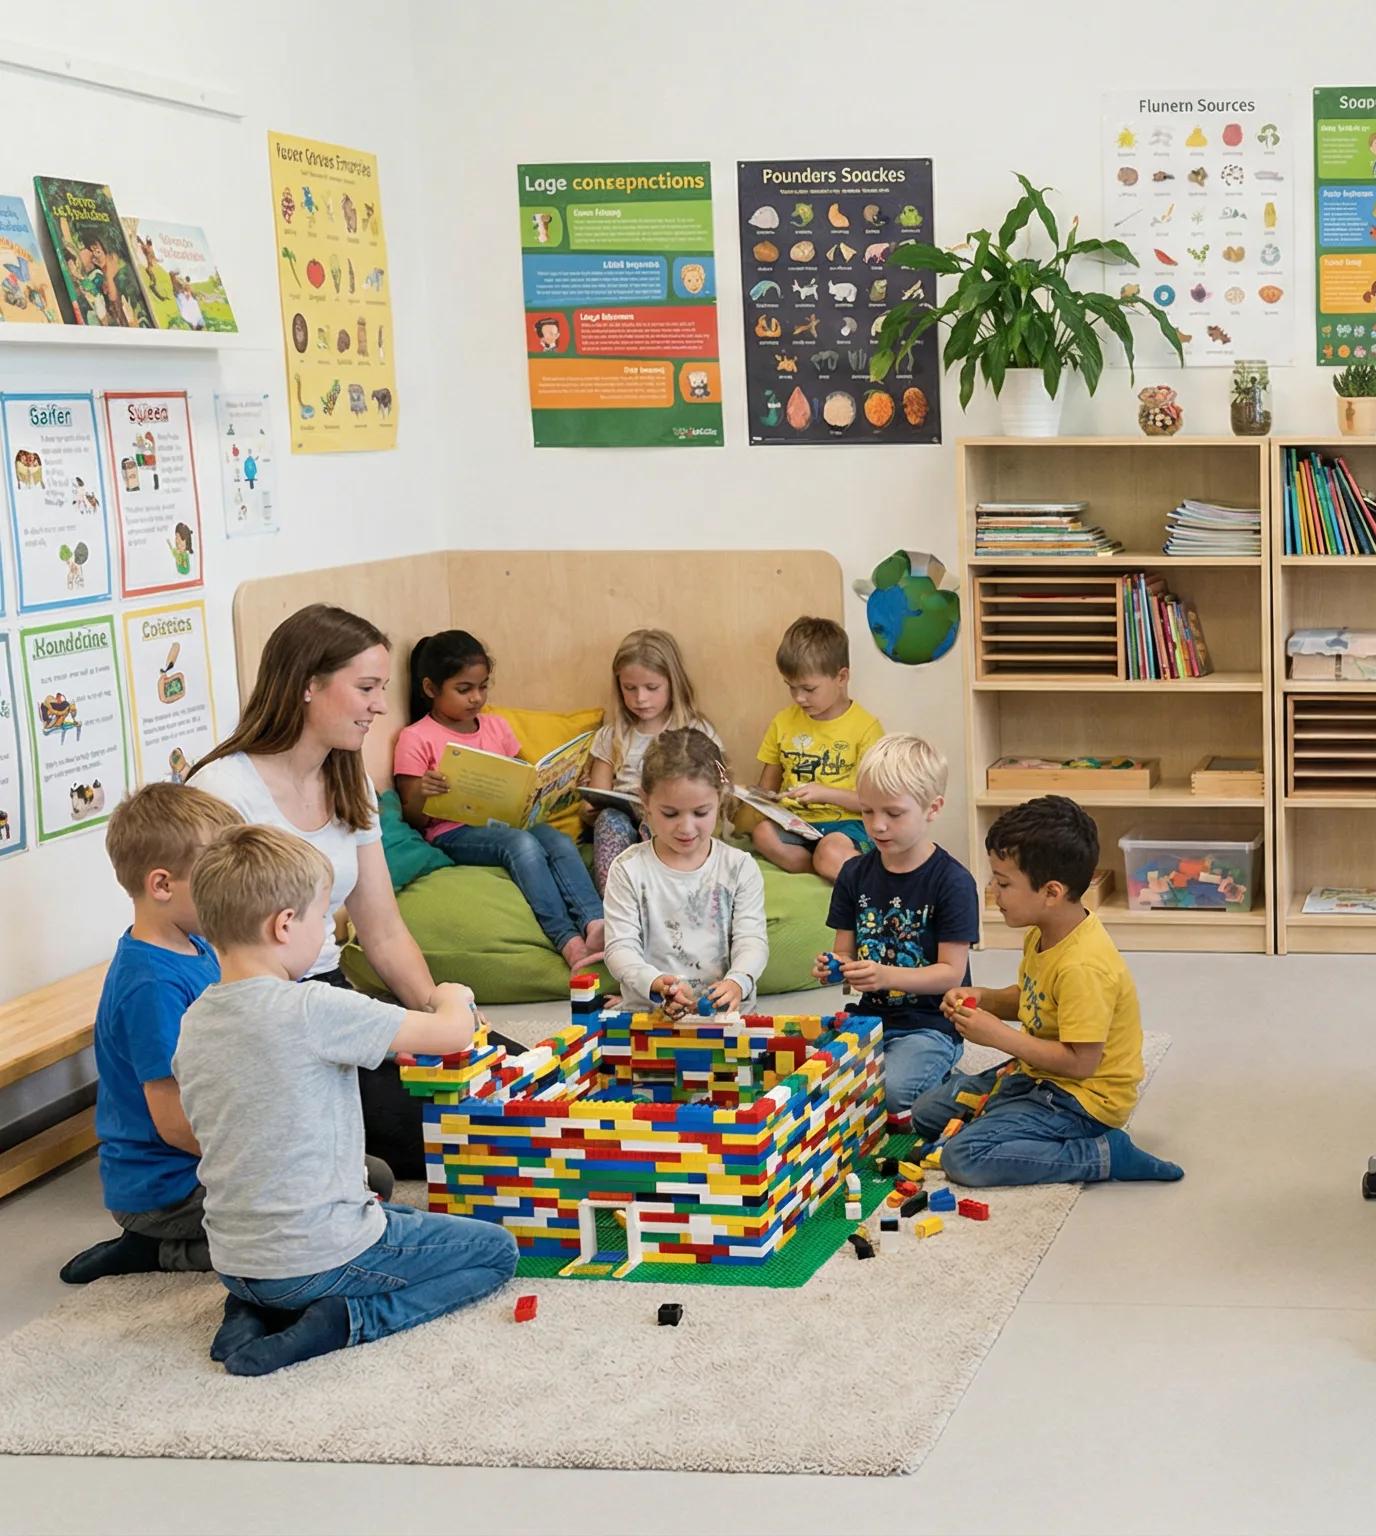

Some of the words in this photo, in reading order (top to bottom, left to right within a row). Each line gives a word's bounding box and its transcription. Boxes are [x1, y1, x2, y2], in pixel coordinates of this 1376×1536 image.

[1197, 98, 1255, 112] Sources
[762, 167, 837, 184] Pounders
[841, 167, 906, 183] Soackes
[524, 175, 567, 195] Lage
